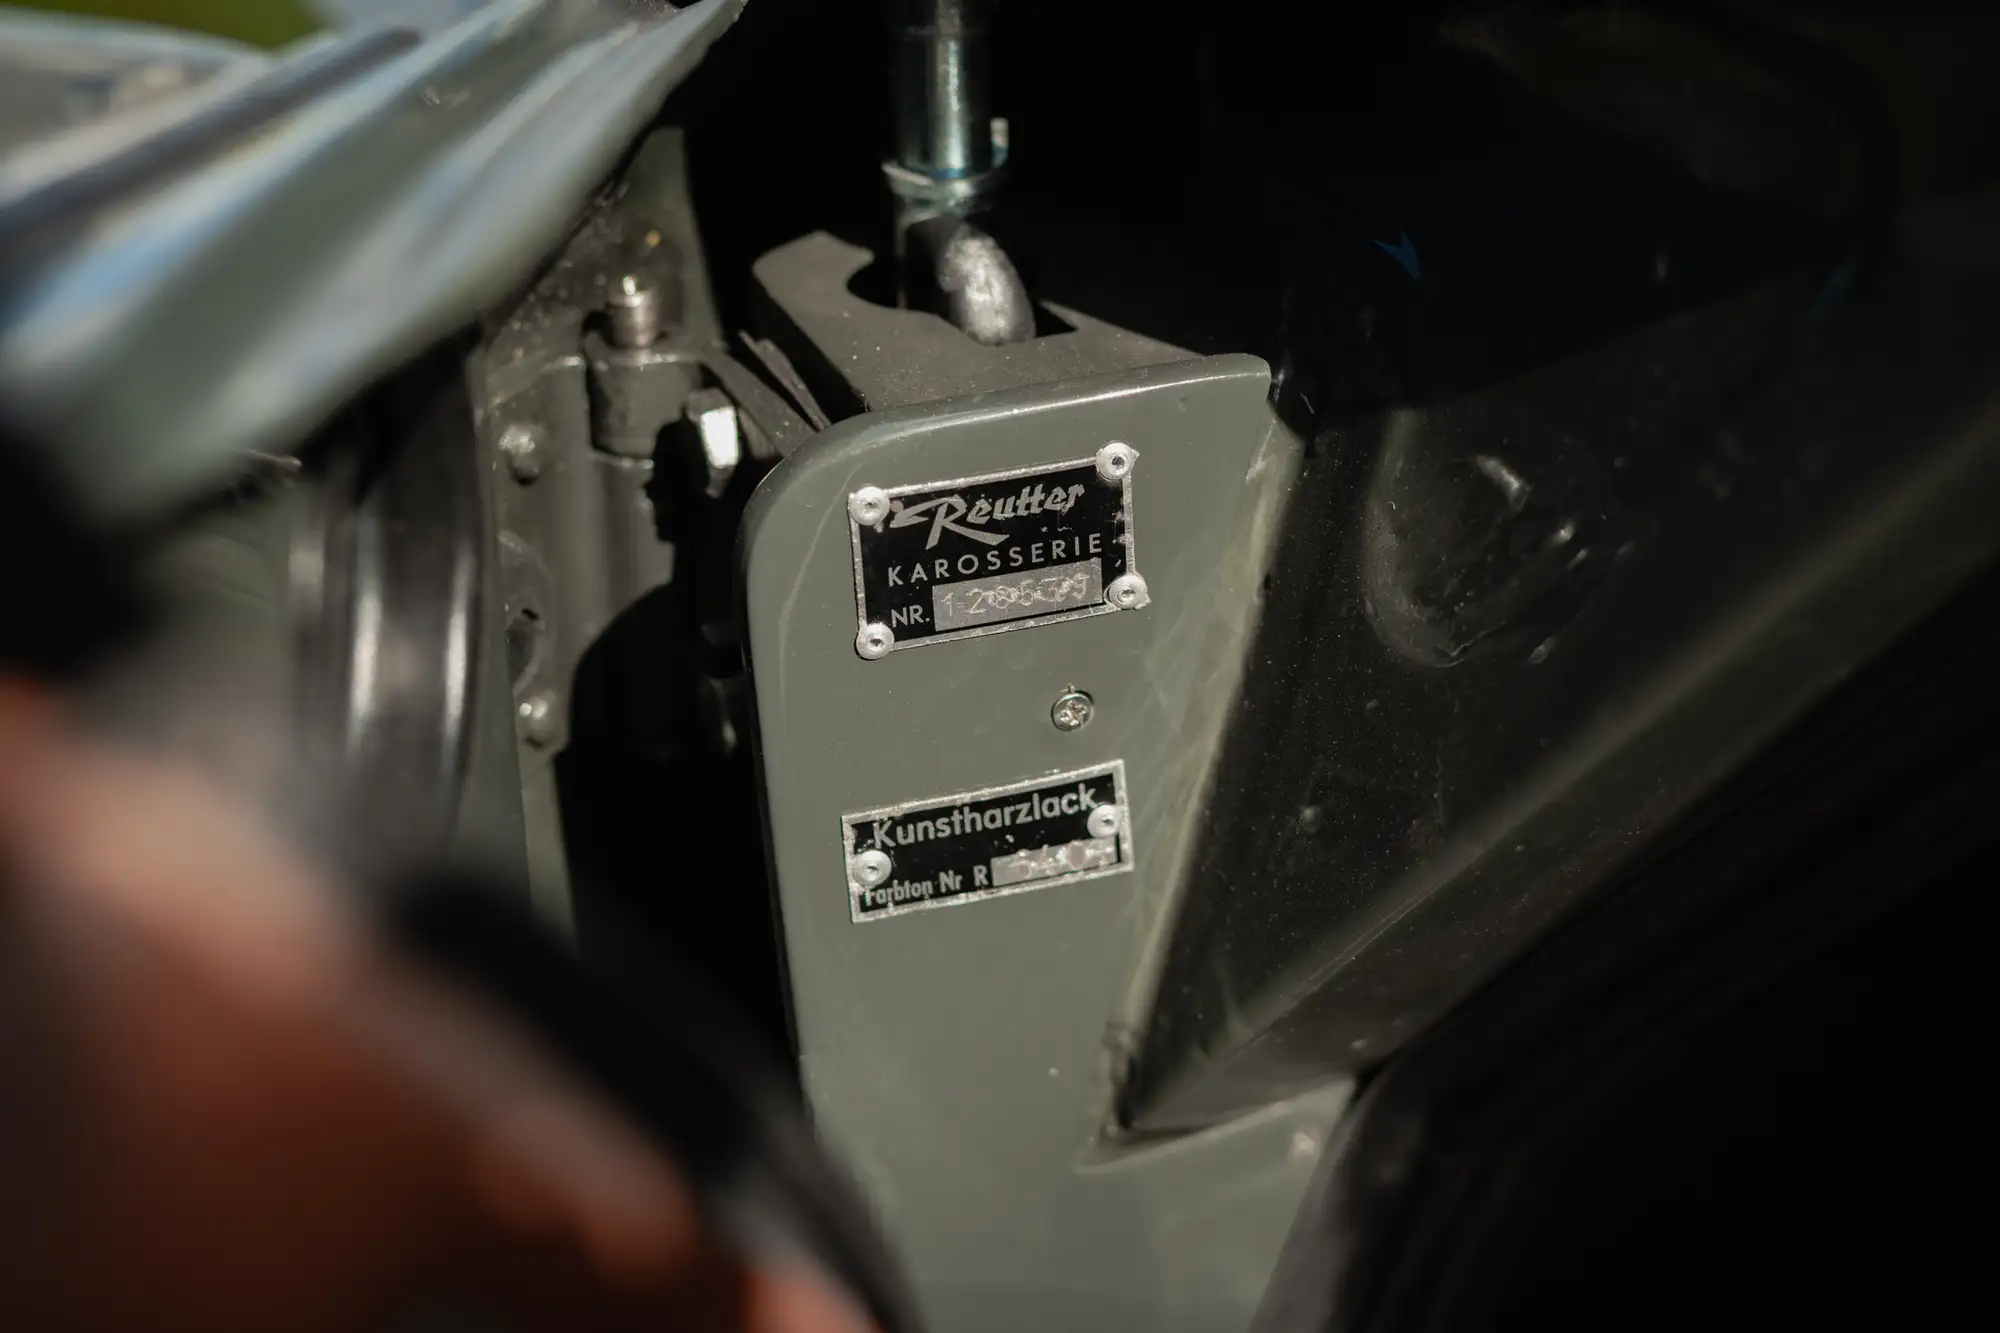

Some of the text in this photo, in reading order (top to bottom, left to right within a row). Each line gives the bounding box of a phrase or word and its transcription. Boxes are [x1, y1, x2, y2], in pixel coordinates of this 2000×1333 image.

[889, 483, 1086, 551] Reutter
[887, 532, 1103, 588] KAROSSERIE
[890, 604, 931, 628] NR.
[872, 782, 1098, 850] Kunstharzlack
[938, 870, 963, 894] Nr
[972, 864, 990, 889] R
